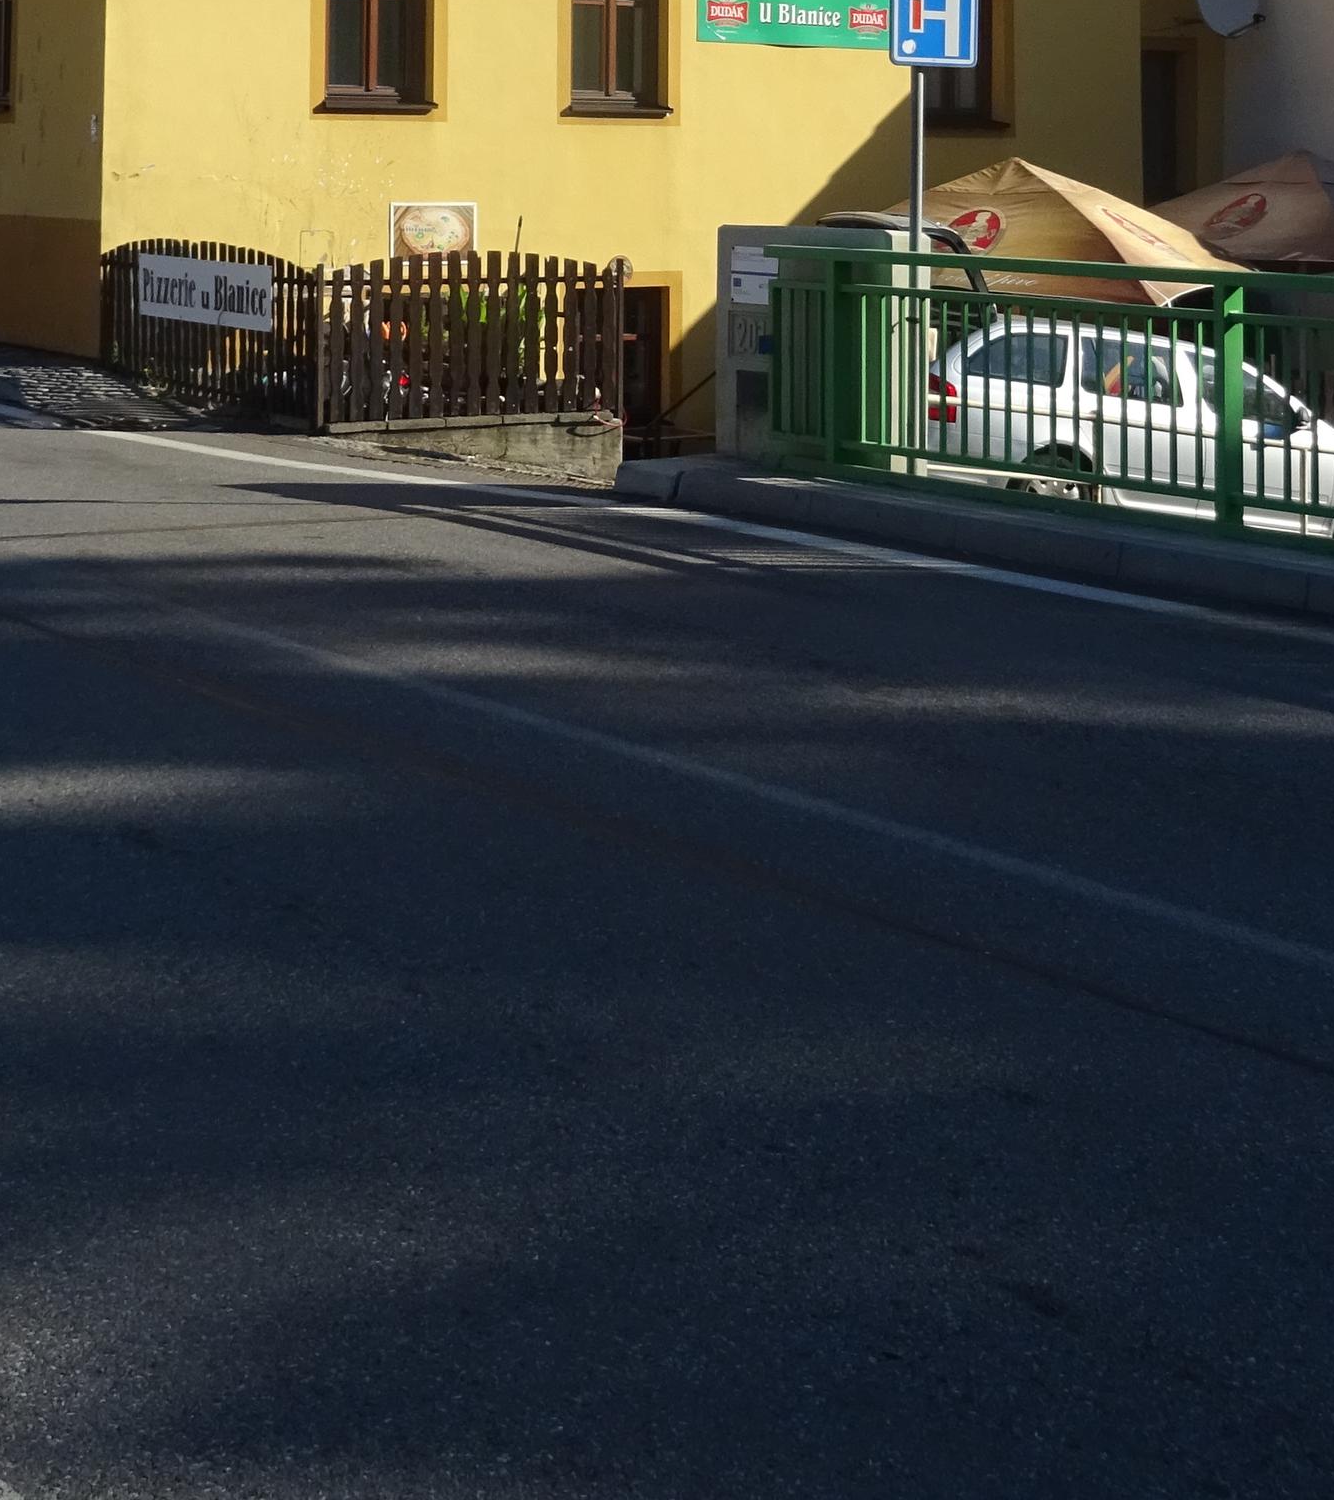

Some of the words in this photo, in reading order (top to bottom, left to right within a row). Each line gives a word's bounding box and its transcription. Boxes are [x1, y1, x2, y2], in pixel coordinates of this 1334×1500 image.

[710, 5, 744, 20] DUDÁK
[759, 2, 773, 24] U
[778, 3, 841, 27] Blanice
[852, 12, 884, 26] DUDÁK
[143, 268, 196, 308] Pizzerie
[201, 290, 210, 309] u
[213, 275, 267, 317] Blanice
